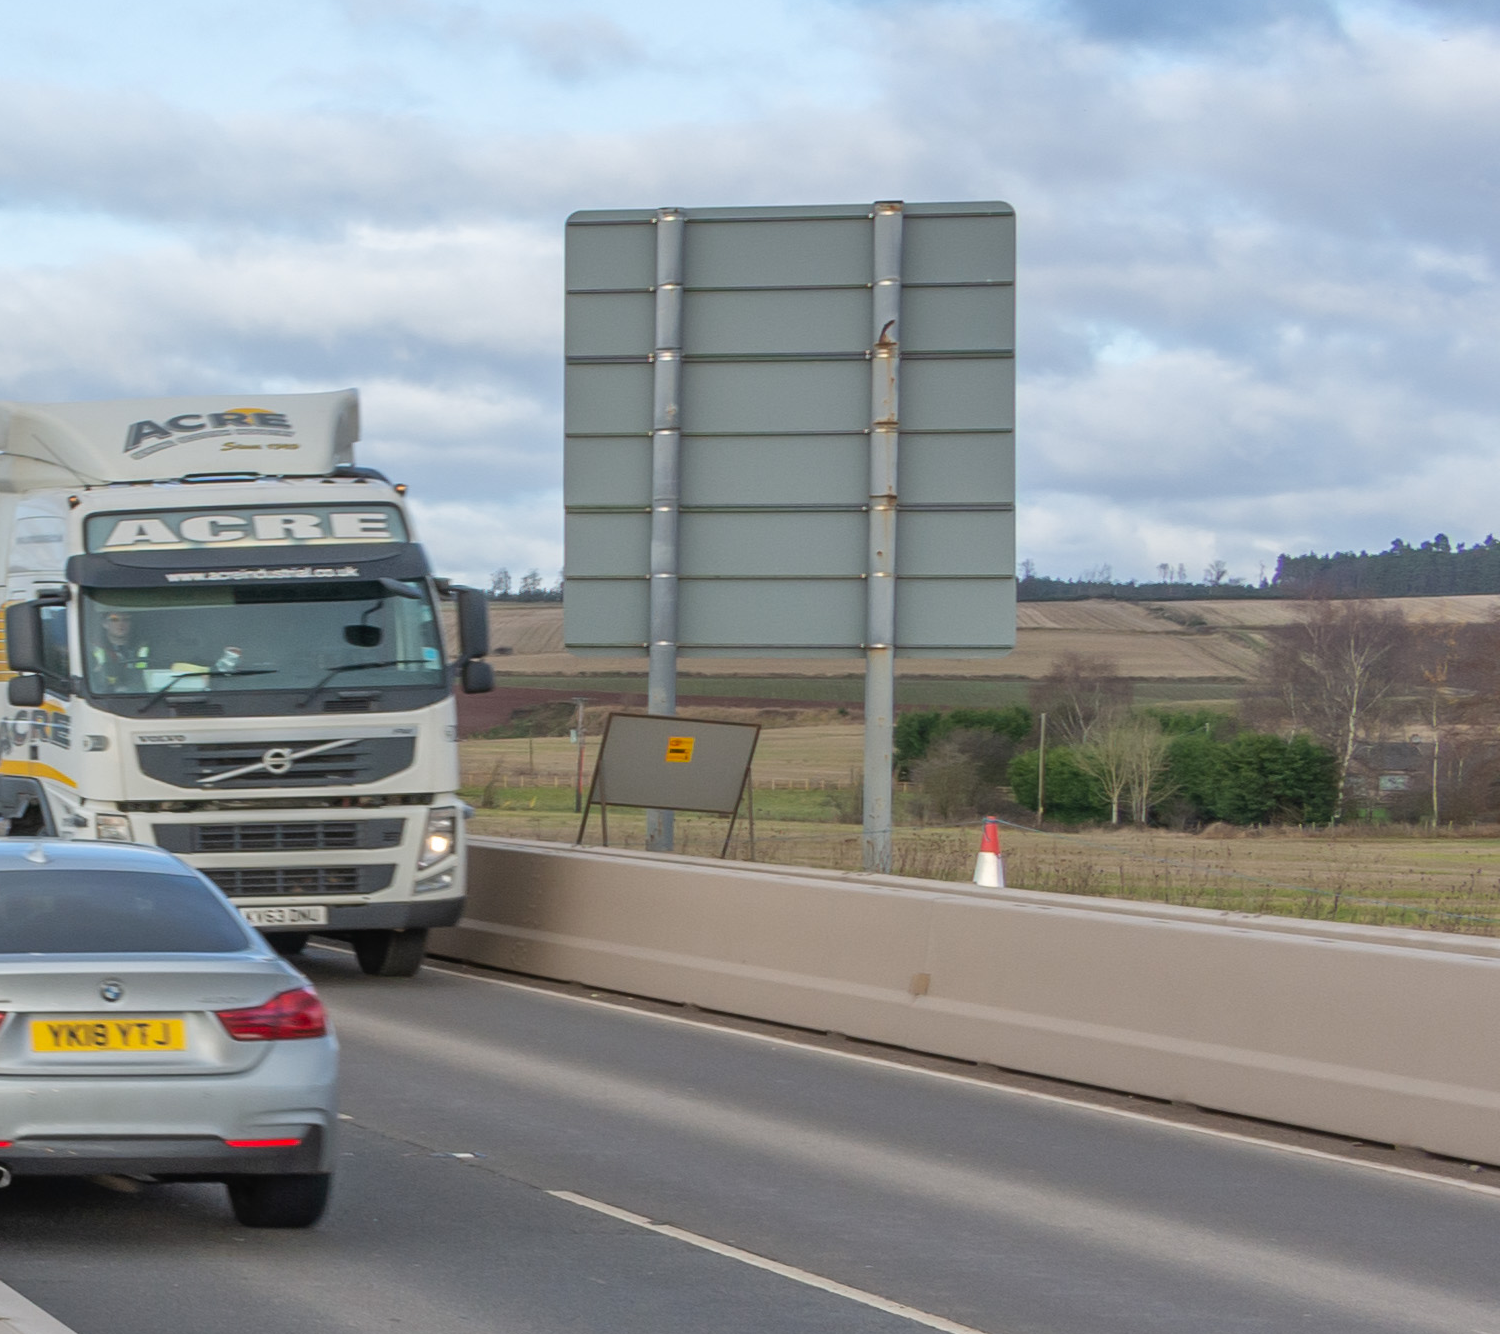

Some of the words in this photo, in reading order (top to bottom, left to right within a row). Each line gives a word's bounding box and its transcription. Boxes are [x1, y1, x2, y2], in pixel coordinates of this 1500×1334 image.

[122, 412, 293, 453] ACRE
[104, 512, 392, 547] ACRE
[137, 734, 187, 743] VOLVO
